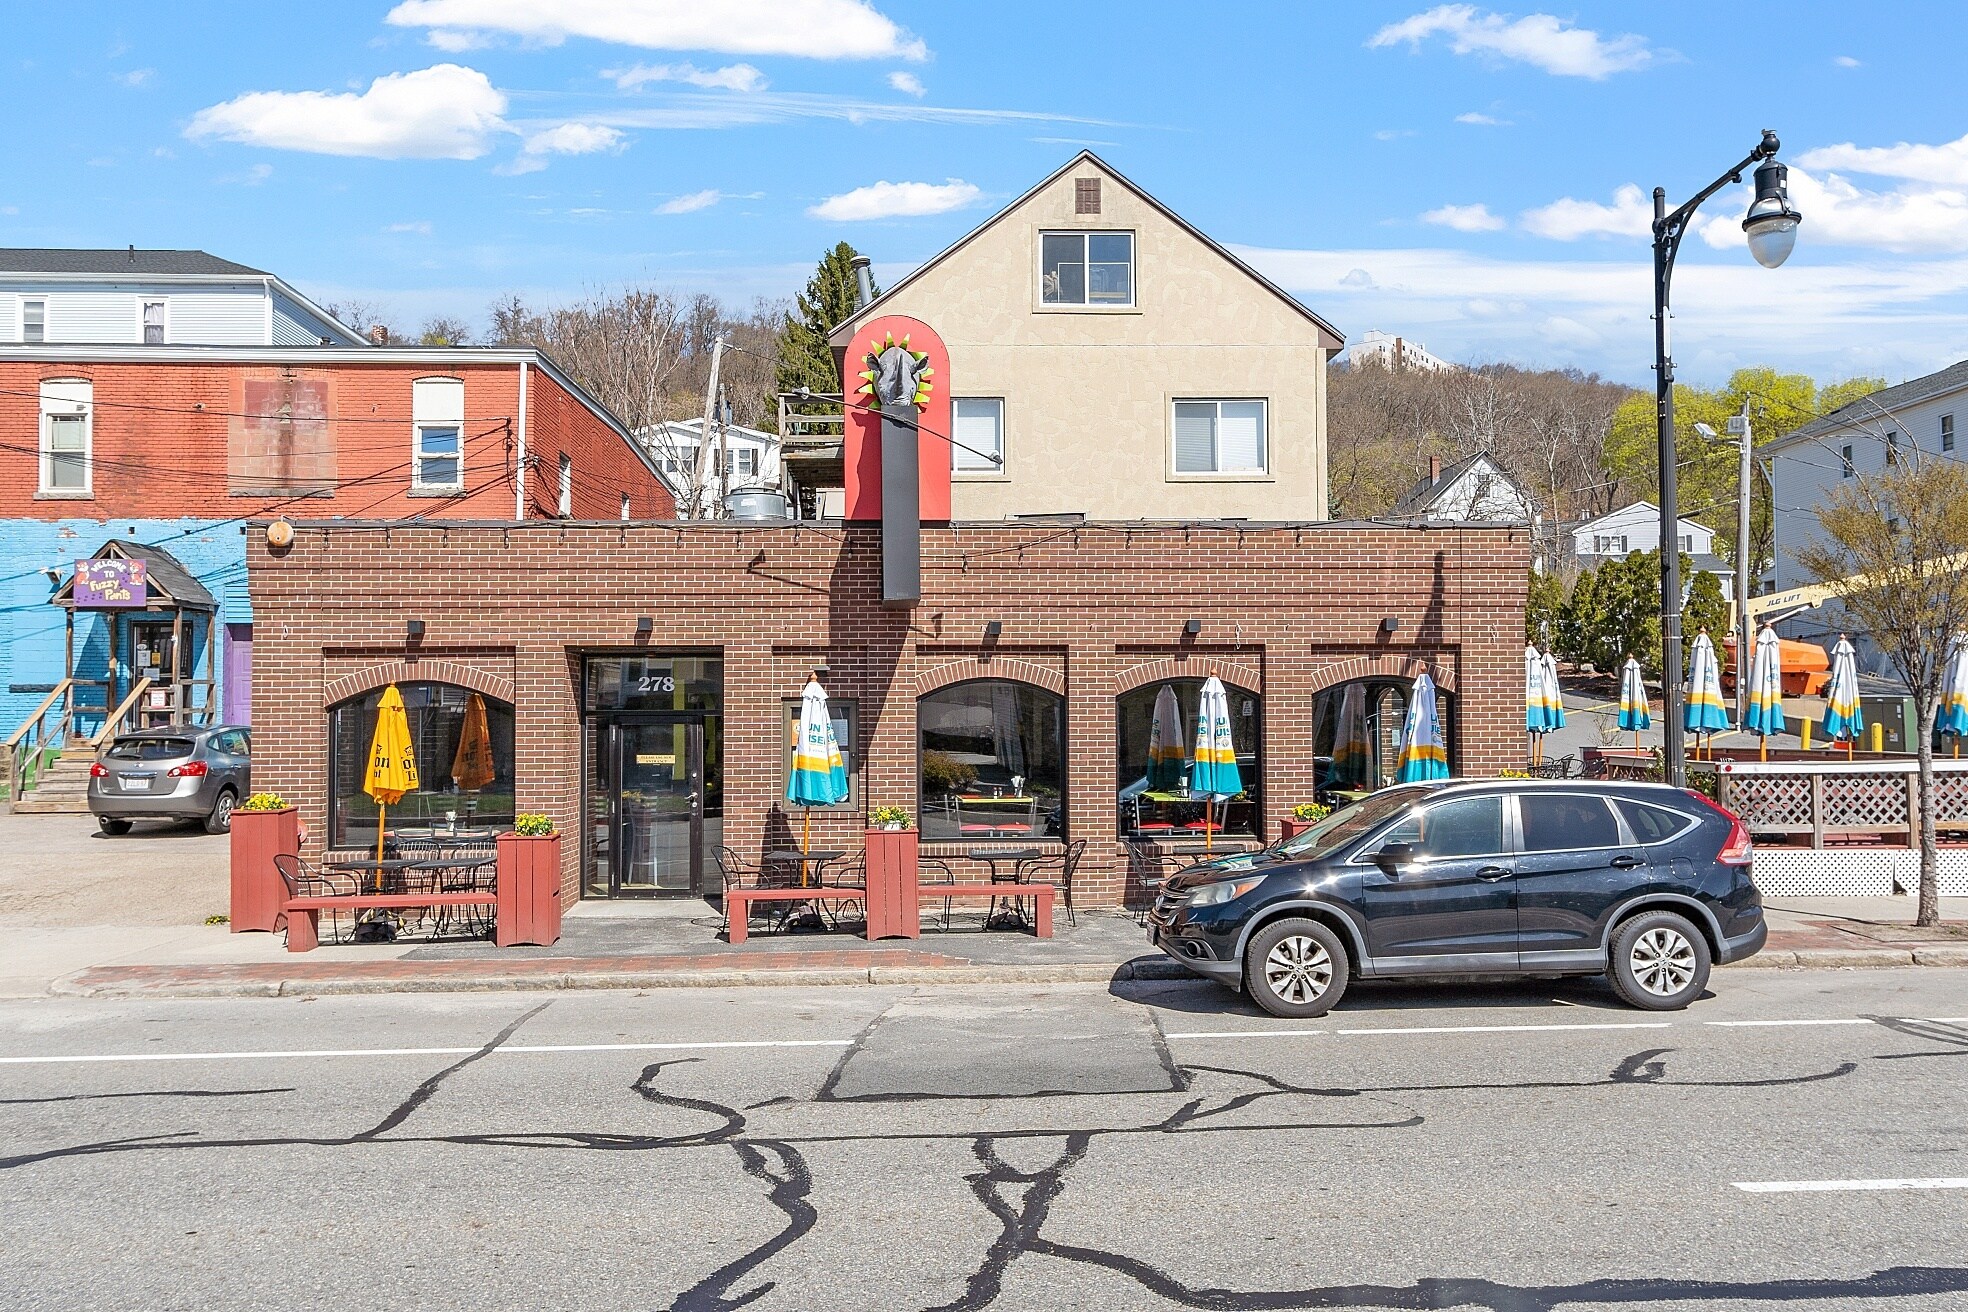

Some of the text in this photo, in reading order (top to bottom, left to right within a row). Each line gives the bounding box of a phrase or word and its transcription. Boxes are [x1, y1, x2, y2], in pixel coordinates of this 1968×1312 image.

[90, 560, 127, 573] WELCOME
[103, 570, 115, 578] TO
[89, 579, 119, 592] Fuzzy
[104, 589, 131, 601] Pants
[1766, 593, 1801, 607] JLG LIFT
[638, 676, 675, 691] 278
